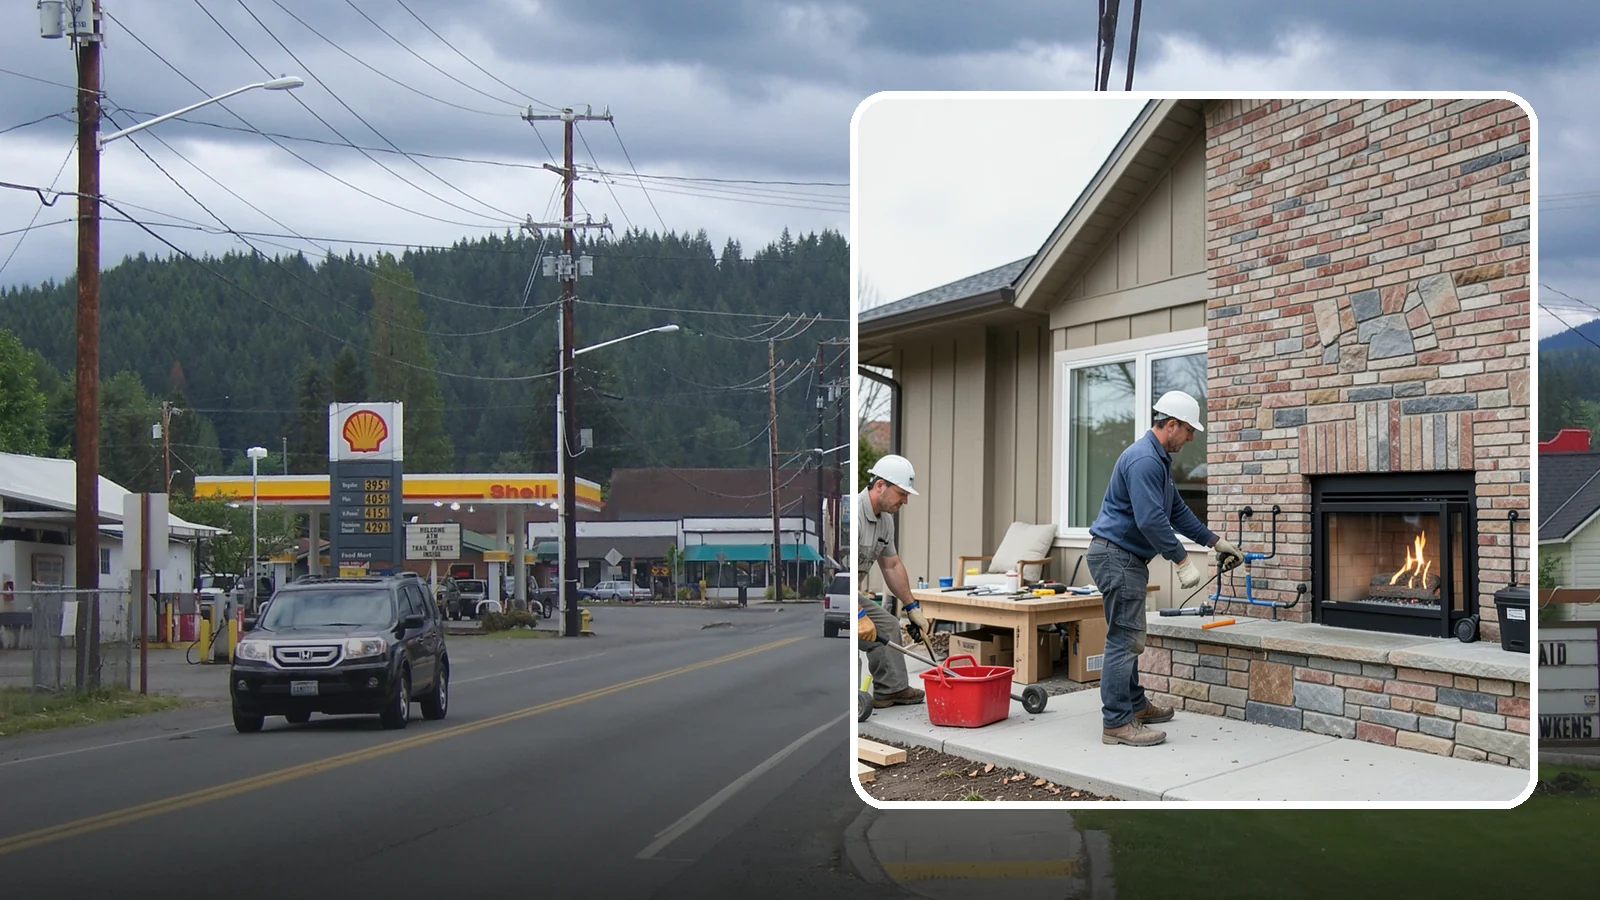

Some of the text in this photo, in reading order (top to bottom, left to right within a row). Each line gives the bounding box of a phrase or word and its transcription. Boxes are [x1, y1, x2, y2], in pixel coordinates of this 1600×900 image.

[366, 480, 384, 490] 395
[490, 484, 547, 498] Shell
[365, 494, 384, 504] 405
[365, 508, 384, 518] 415
[365, 522, 384, 532] 429
[1539, 643, 1566, 665] AID
[1539, 716, 1592, 739] WKENS
